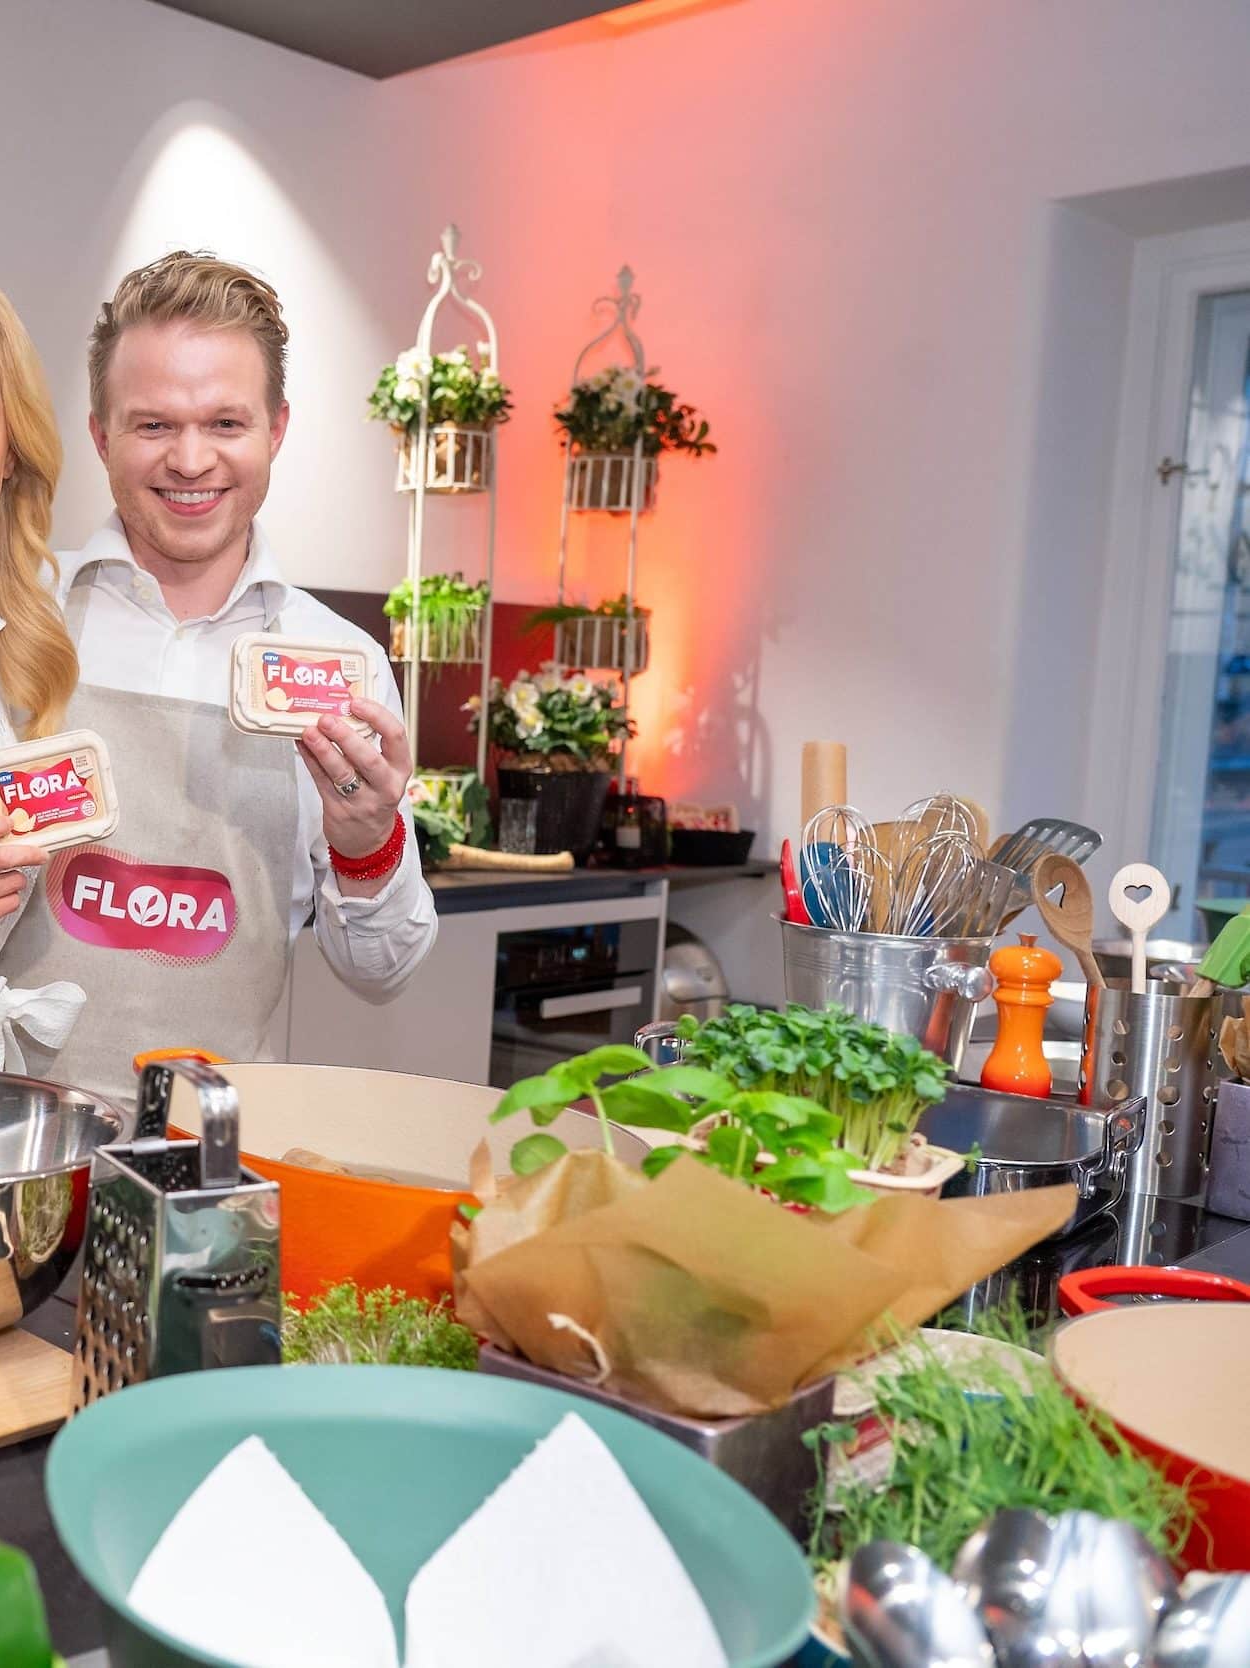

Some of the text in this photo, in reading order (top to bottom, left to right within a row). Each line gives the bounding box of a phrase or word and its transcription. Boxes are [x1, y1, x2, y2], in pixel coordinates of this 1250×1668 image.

[267, 664, 346, 687] FLORA
[3, 771, 82, 804] FLORA
[71, 874, 227, 932] FLORA
